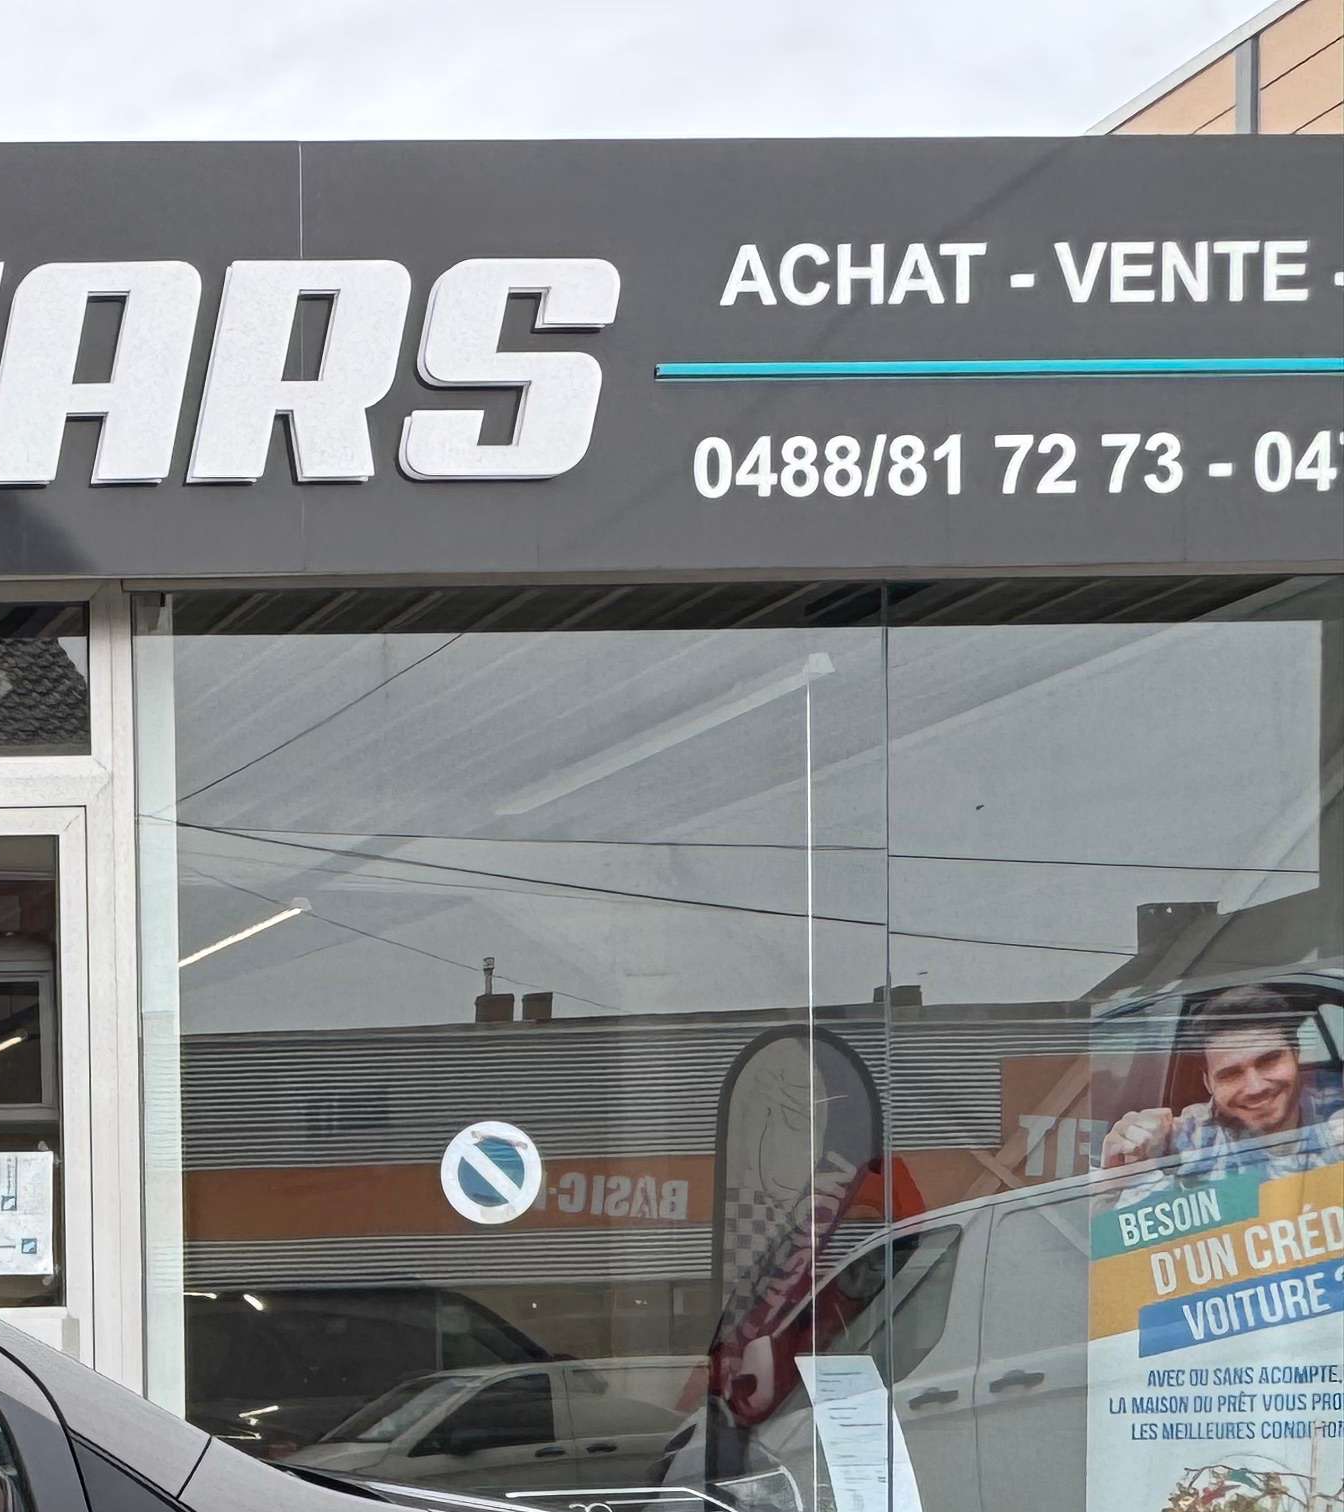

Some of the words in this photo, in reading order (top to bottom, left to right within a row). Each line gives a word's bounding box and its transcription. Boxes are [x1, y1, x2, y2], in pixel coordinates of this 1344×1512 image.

[720, 242, 987, 306] ACHAT
[1054, 240, 1310, 302] VENTE
[693, 434, 962, 497] 0488/81
[994, 434, 1077, 493] 72
[1100, 432, 1184, 492] 73
[1254, 430, 1344, 492] 04
[1118, 1188, 1222, 1247] BESOIN
[1150, 1233, 1239, 1296] D'UN
[1182, 1271, 1332, 1341] VOITURE
[1109, 1397, 1127, 1415] LA
[1131, 1396, 1189, 1414] MAISON
[1193, 1395, 1213, 1414] DU
[1217, 1391, 1257, 1413] PRÊT
[1262, 1393, 1307, 1412] VOUS
[1312, 1393, 1344, 1411] PRO
[1147, 1369, 1185, 1388] AVEC
[1190, 1369, 1209, 1387] OU
[1213, 1368, 1254, 1386] SANS
[1131, 1423, 1158, 1441] LES
[1162, 1421, 1256, 1441] MEILLEURES
